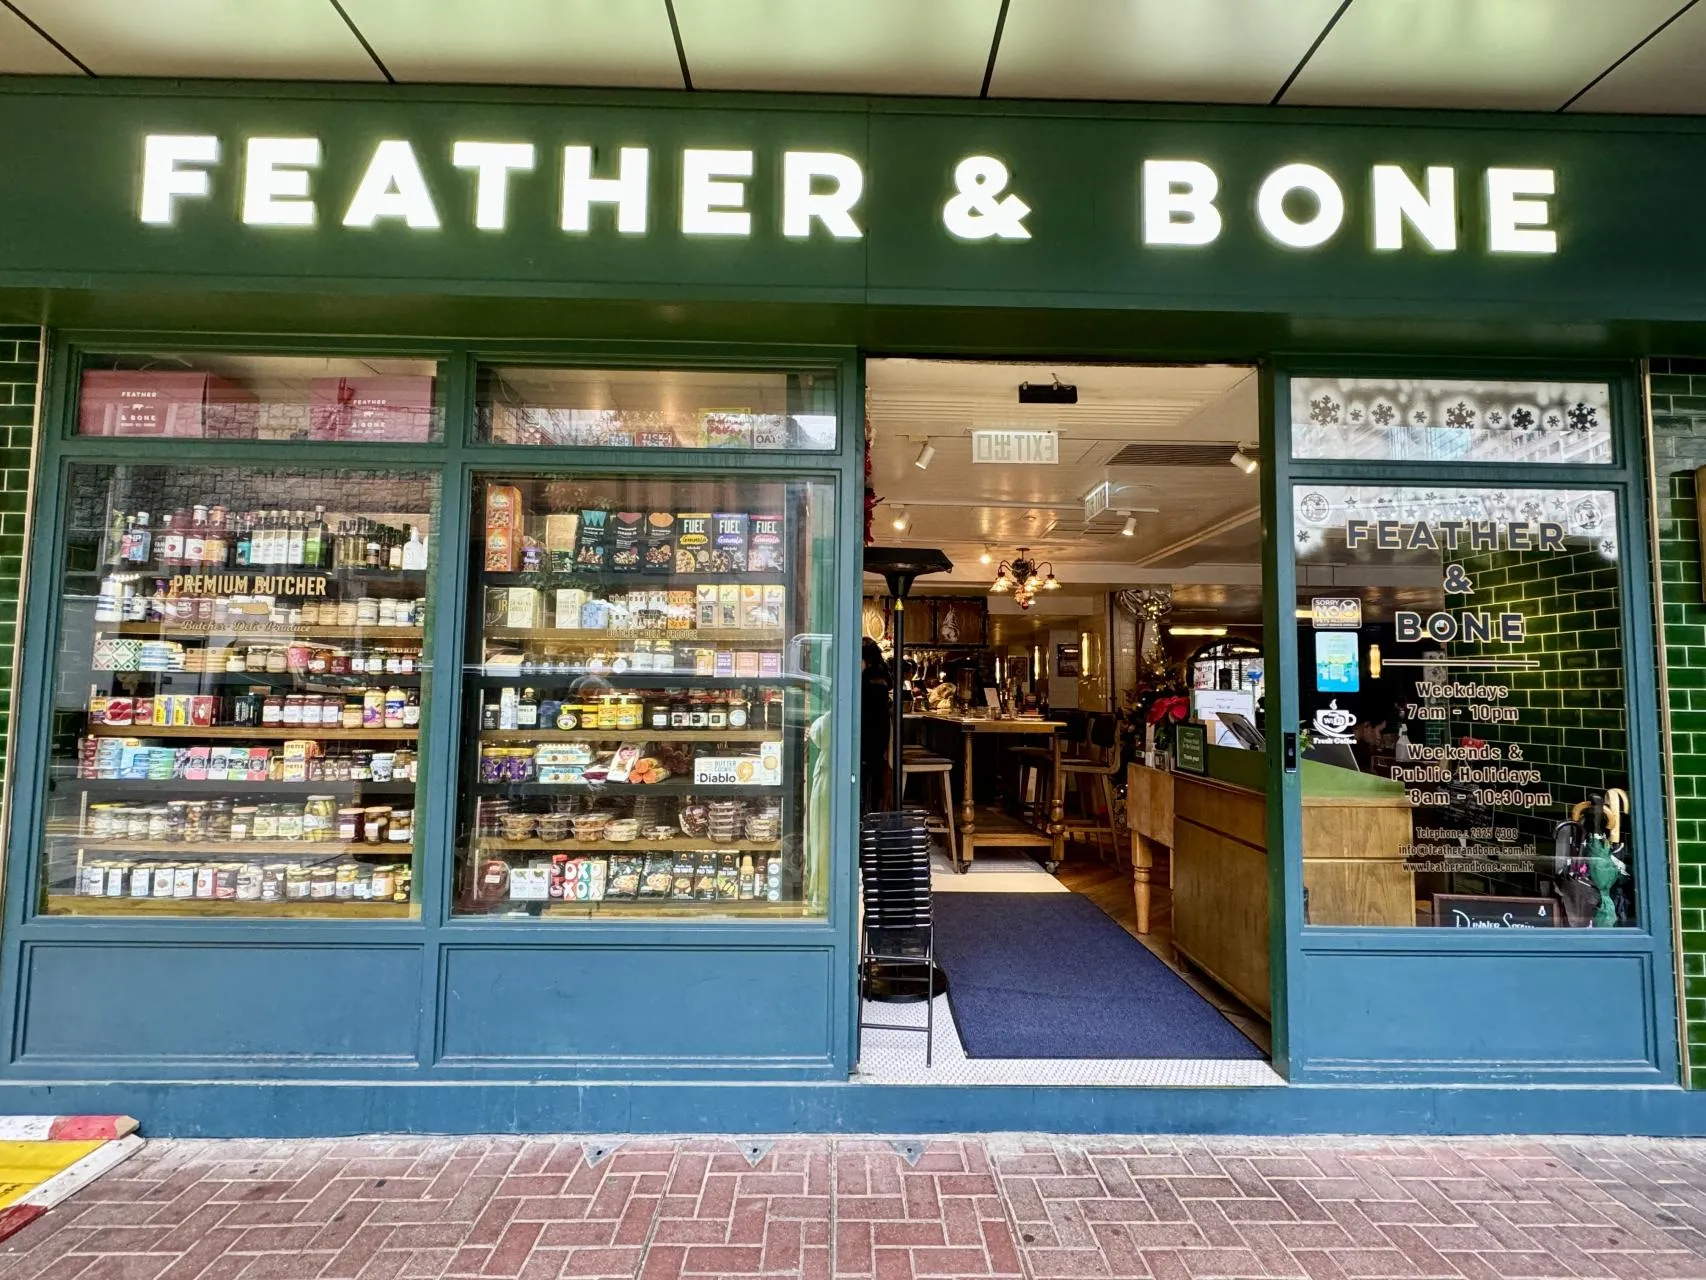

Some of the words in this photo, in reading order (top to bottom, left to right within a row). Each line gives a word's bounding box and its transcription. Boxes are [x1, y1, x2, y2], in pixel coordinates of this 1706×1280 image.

[141, 135, 864, 238] FEATHER
[943, 155, 1032, 239] &
[1144, 160, 1557, 253] BONE
[1346, 519, 1567, 551] FEATHER
[173, 574, 249, 594] PREMIUM
[254, 575, 328, 596] BUTCHER
[1443, 564, 1474, 594] &
[1315, 605, 1341, 618] NO
[1395, 612, 1526, 643] BONE
[1415, 682, 1509, 701] Weekdays
[1406, 703, 1446, 720] 7am
[1468, 704, 1519, 723] 10pm
[1406, 743, 1502, 760] Weekends
[1508, 744, 1524, 760] &
[699, 772, 737, 783] Diablo
[1390, 766, 1451, 783] Public
[1459, 767, 1541, 785] Holidays
[1409, 788, 1450, 805] 8am
[1473, 789, 1552, 808] 10:30pm
[1415, 827, 1461, 841] Telephone
[1470, 828, 1493, 839] 2325
[1398, 844, 1537, 857] info@featherandbone.com.hk
[1402, 860, 1535, 873] www.featherandbone.com.hk
